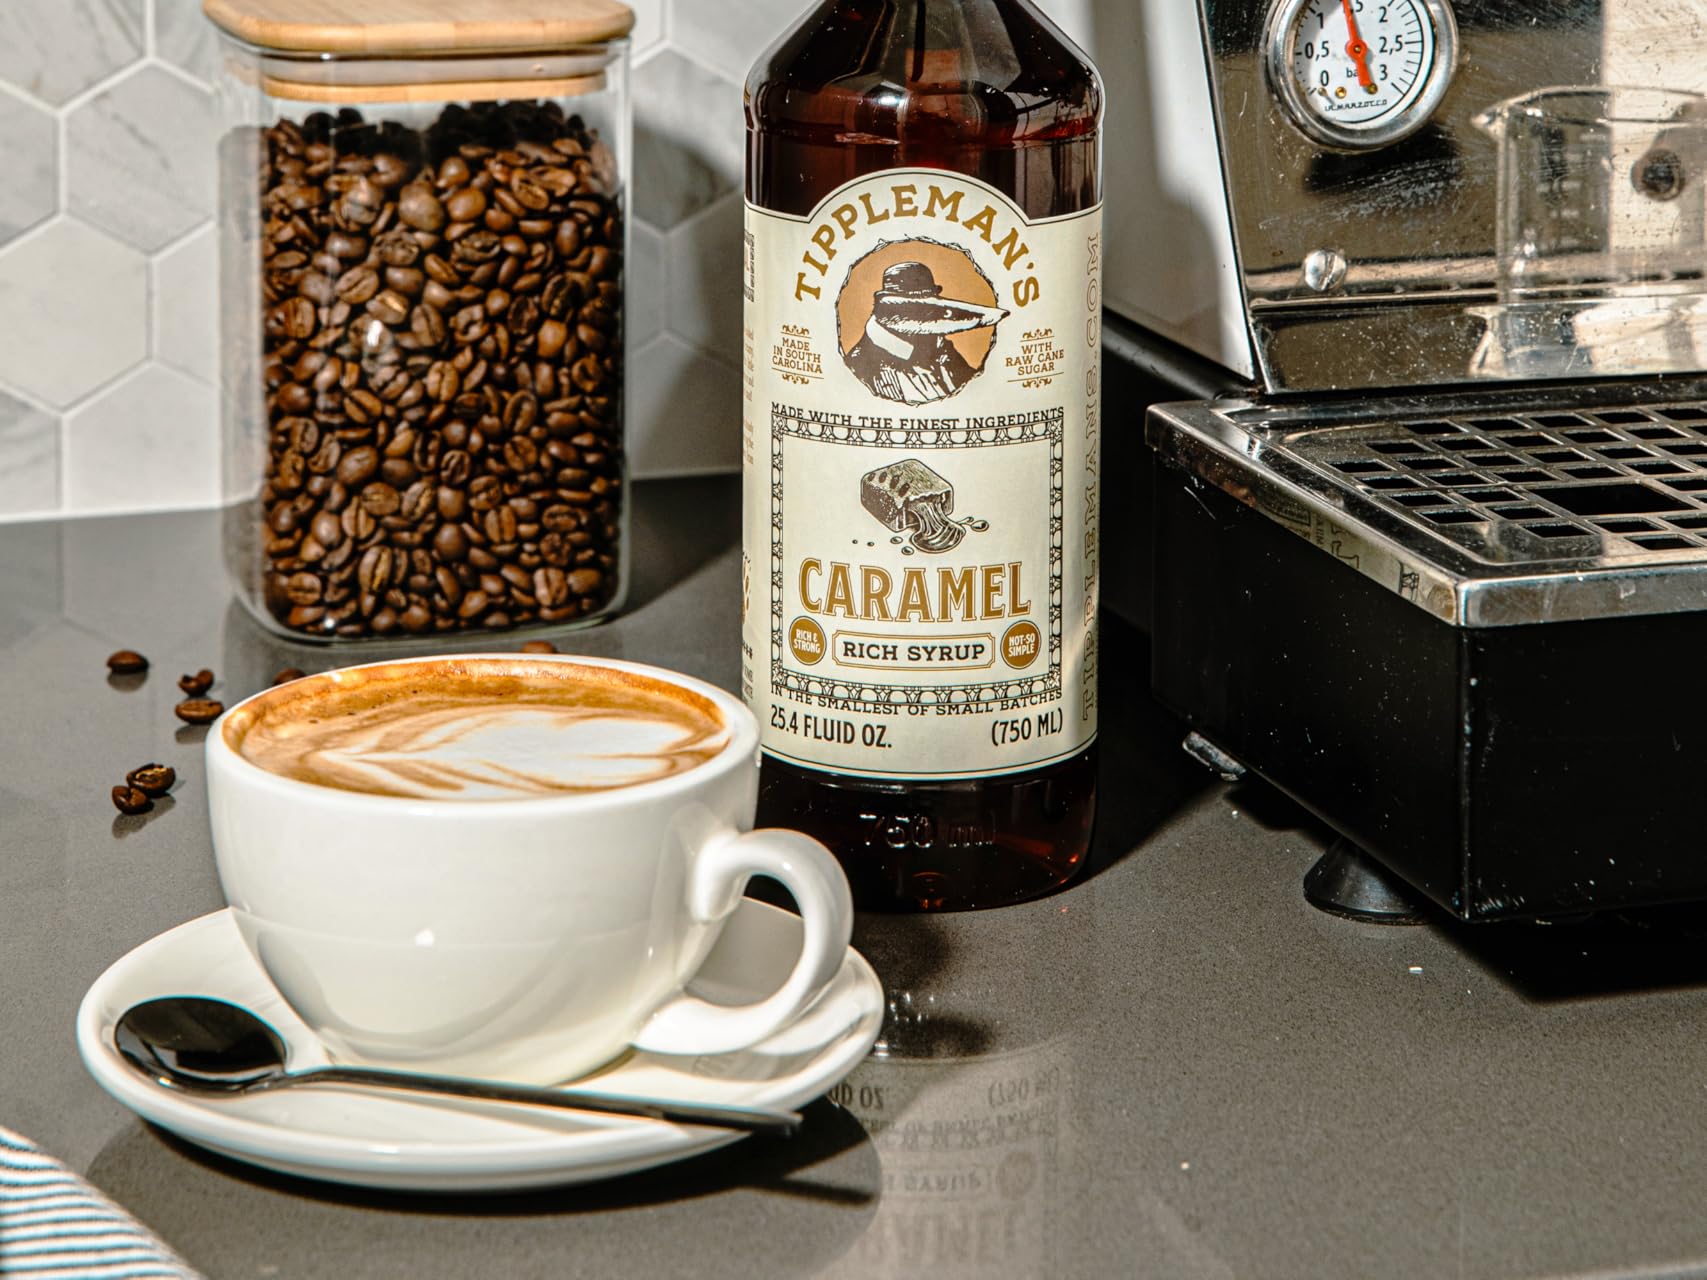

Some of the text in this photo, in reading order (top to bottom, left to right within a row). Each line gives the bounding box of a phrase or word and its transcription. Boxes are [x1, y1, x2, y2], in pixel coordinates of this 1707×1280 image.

[1315, 12, 1325, 29] 1
[1379, 6, 1388, 23] 2
[1304, 41, 1330, 61] 0,5
[1379, 35, 1403, 55] 2,5
[1320, 69, 1330, 87] 0
[1346, 66, 1359, 79] ba
[1379, 64, 1388, 81] 3
[795, 184, 1039, 307] TIPPLEMAN'S
[782, 337, 810, 351] MADE
[1021, 341, 1052, 355] WITH
[773, 344, 821, 363] IN SOUTH
[1005, 349, 1064, 367] RAW CANE
[772, 355, 823, 374] CAROLINA
[1017, 361, 1055, 376] SUGAR
[771, 401, 1064, 430] MADE WITH THE FINEST INGREDIENTS
[798, 557, 1031, 623] CARAMEL
[796, 628, 812, 642] RICH
[1008, 632, 1036, 646] NOT-SO
[793, 638, 821, 654] STRONG
[843, 640, 985, 662] RICH SYRUP
[1008, 643, 1035, 658] SIMPLE
[771, 683, 1063, 716] IN THE SMALLEST OF SMALL BATCHES
[770, 704, 893, 749] 25.4 FLUID OZ.
[991, 707, 1063, 747] (750 ML)
